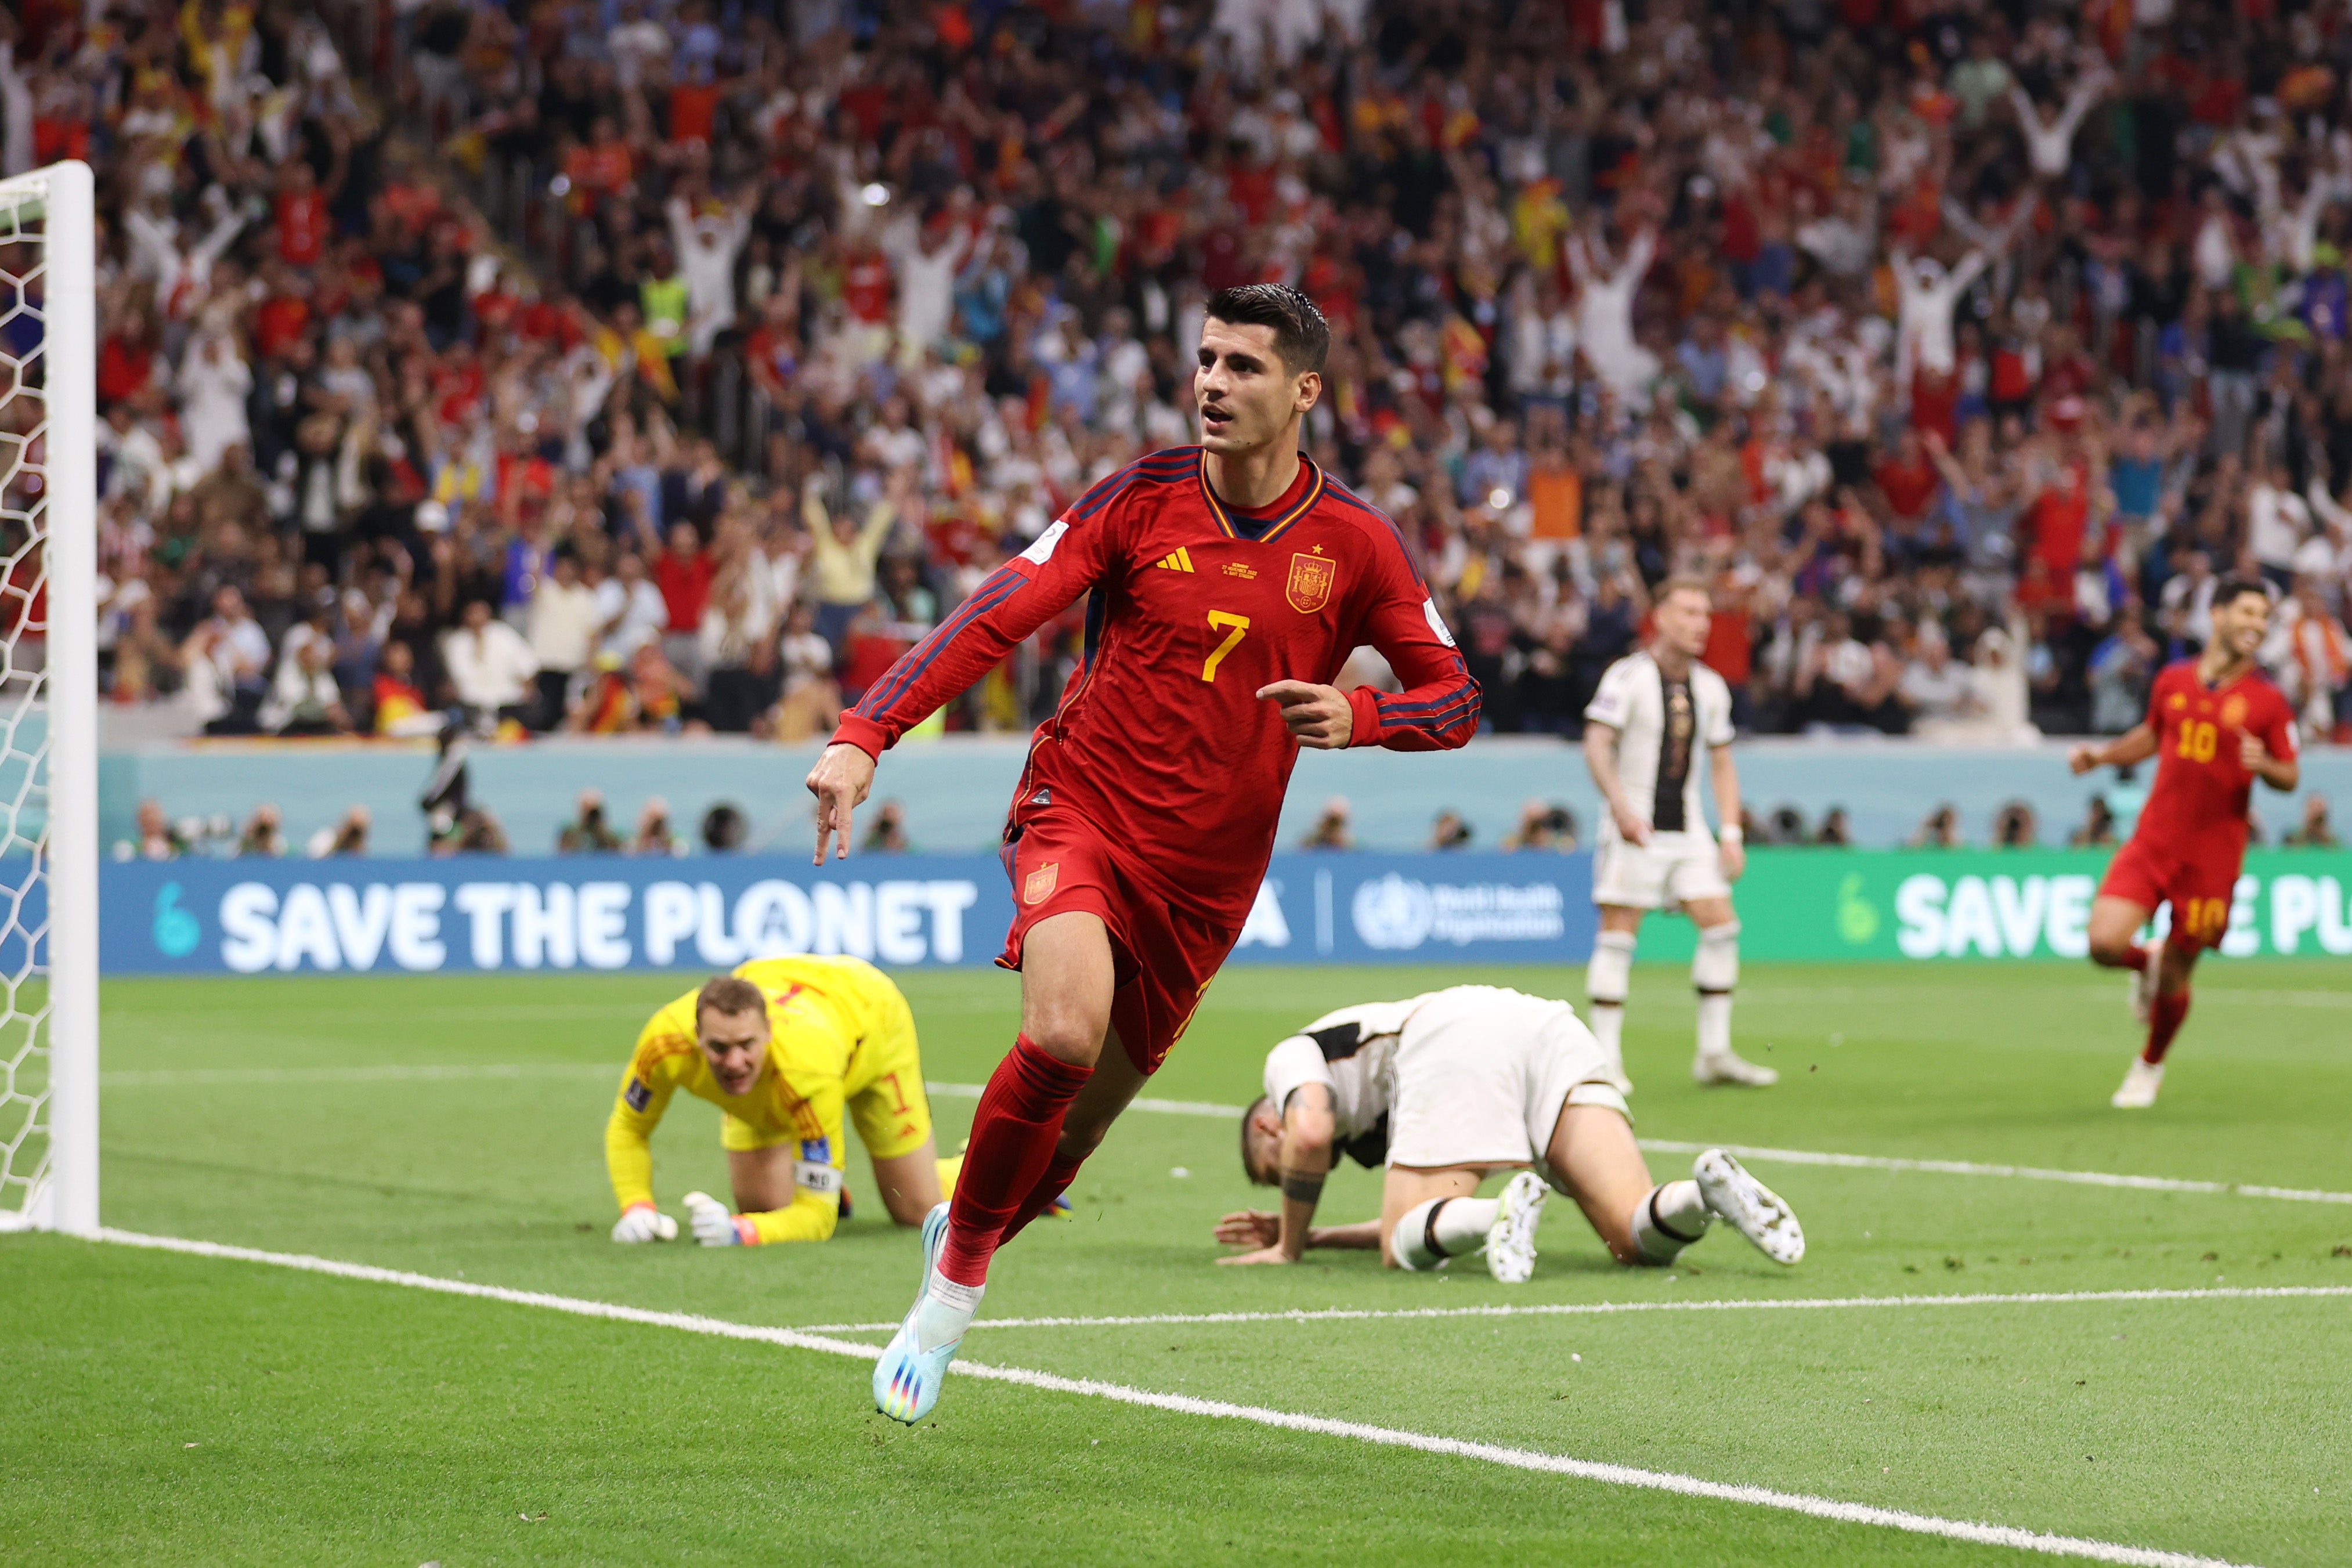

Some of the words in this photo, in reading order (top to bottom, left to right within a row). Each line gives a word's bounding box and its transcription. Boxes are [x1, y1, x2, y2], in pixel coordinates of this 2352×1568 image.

[1202, 609, 1250, 682] 7
[2178, 717, 2217, 764] 10
[219, 881, 447, 972] SAVE
[454, 882, 633, 969] THE
[1895, 873, 2096, 959] SAVE
[2271, 873, 2352, 955] PL
[2185, 897, 2227, 938] 10
[881, 1072, 913, 1117] 1
